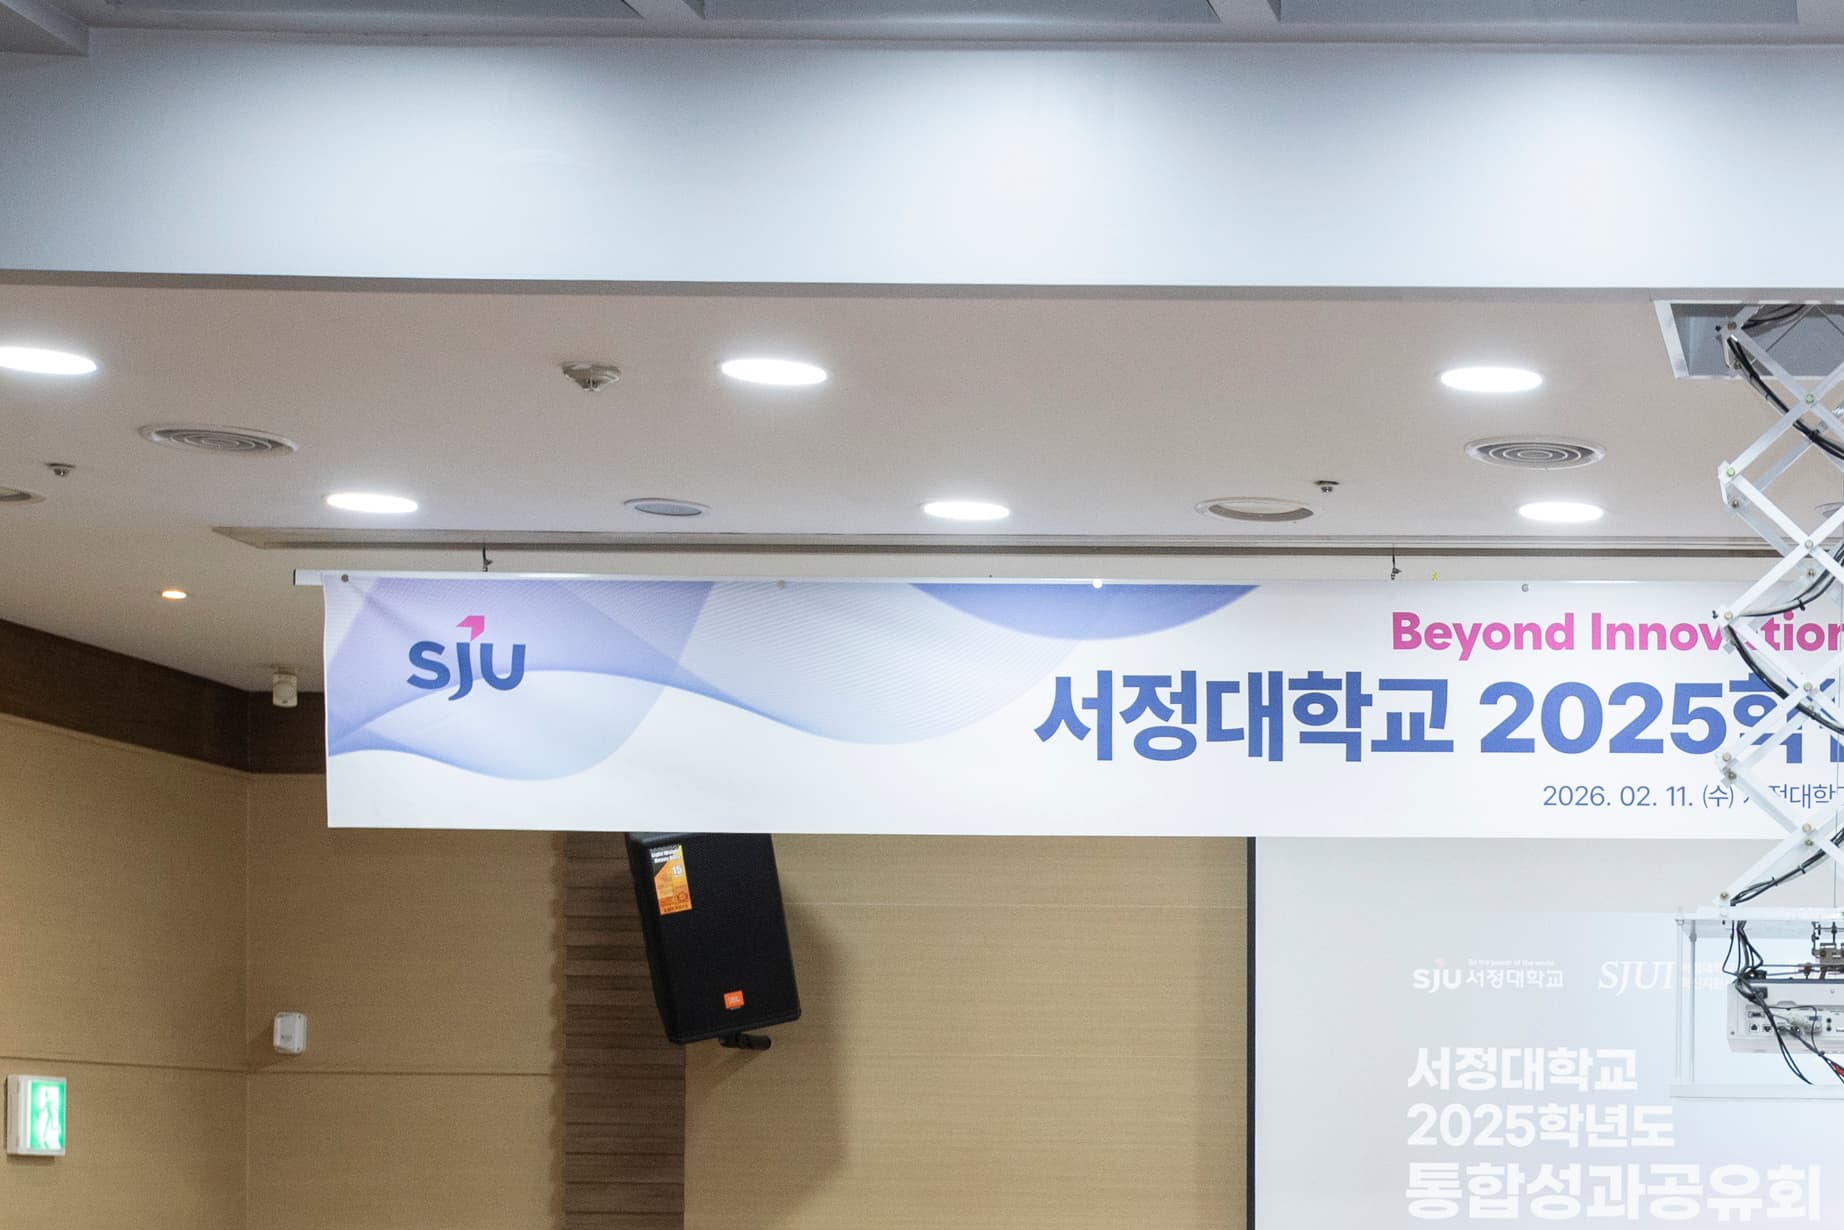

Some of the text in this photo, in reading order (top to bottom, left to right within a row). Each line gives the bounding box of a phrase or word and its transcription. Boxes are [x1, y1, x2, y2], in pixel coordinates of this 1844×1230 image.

[1392, 612, 1574, 661] Beyond
[1034, 670, 1454, 762] 서정대학교
[1543, 785, 1611, 807] 2026.
[1620, 785, 1657, 807] 02.
[1665, 785, 1692, 807] 11.
[1702, 784, 1735, 809] (수)
[1465, 968, 1564, 990] 서정대학교
[1599, 960, 1676, 997] SJUI
[1407, 1047, 1638, 1092] 서정대학교
[1407, 1103, 1676, 1148] 2025학년도
[1405, 1162, 1822, 1222] 통합성과공유회
